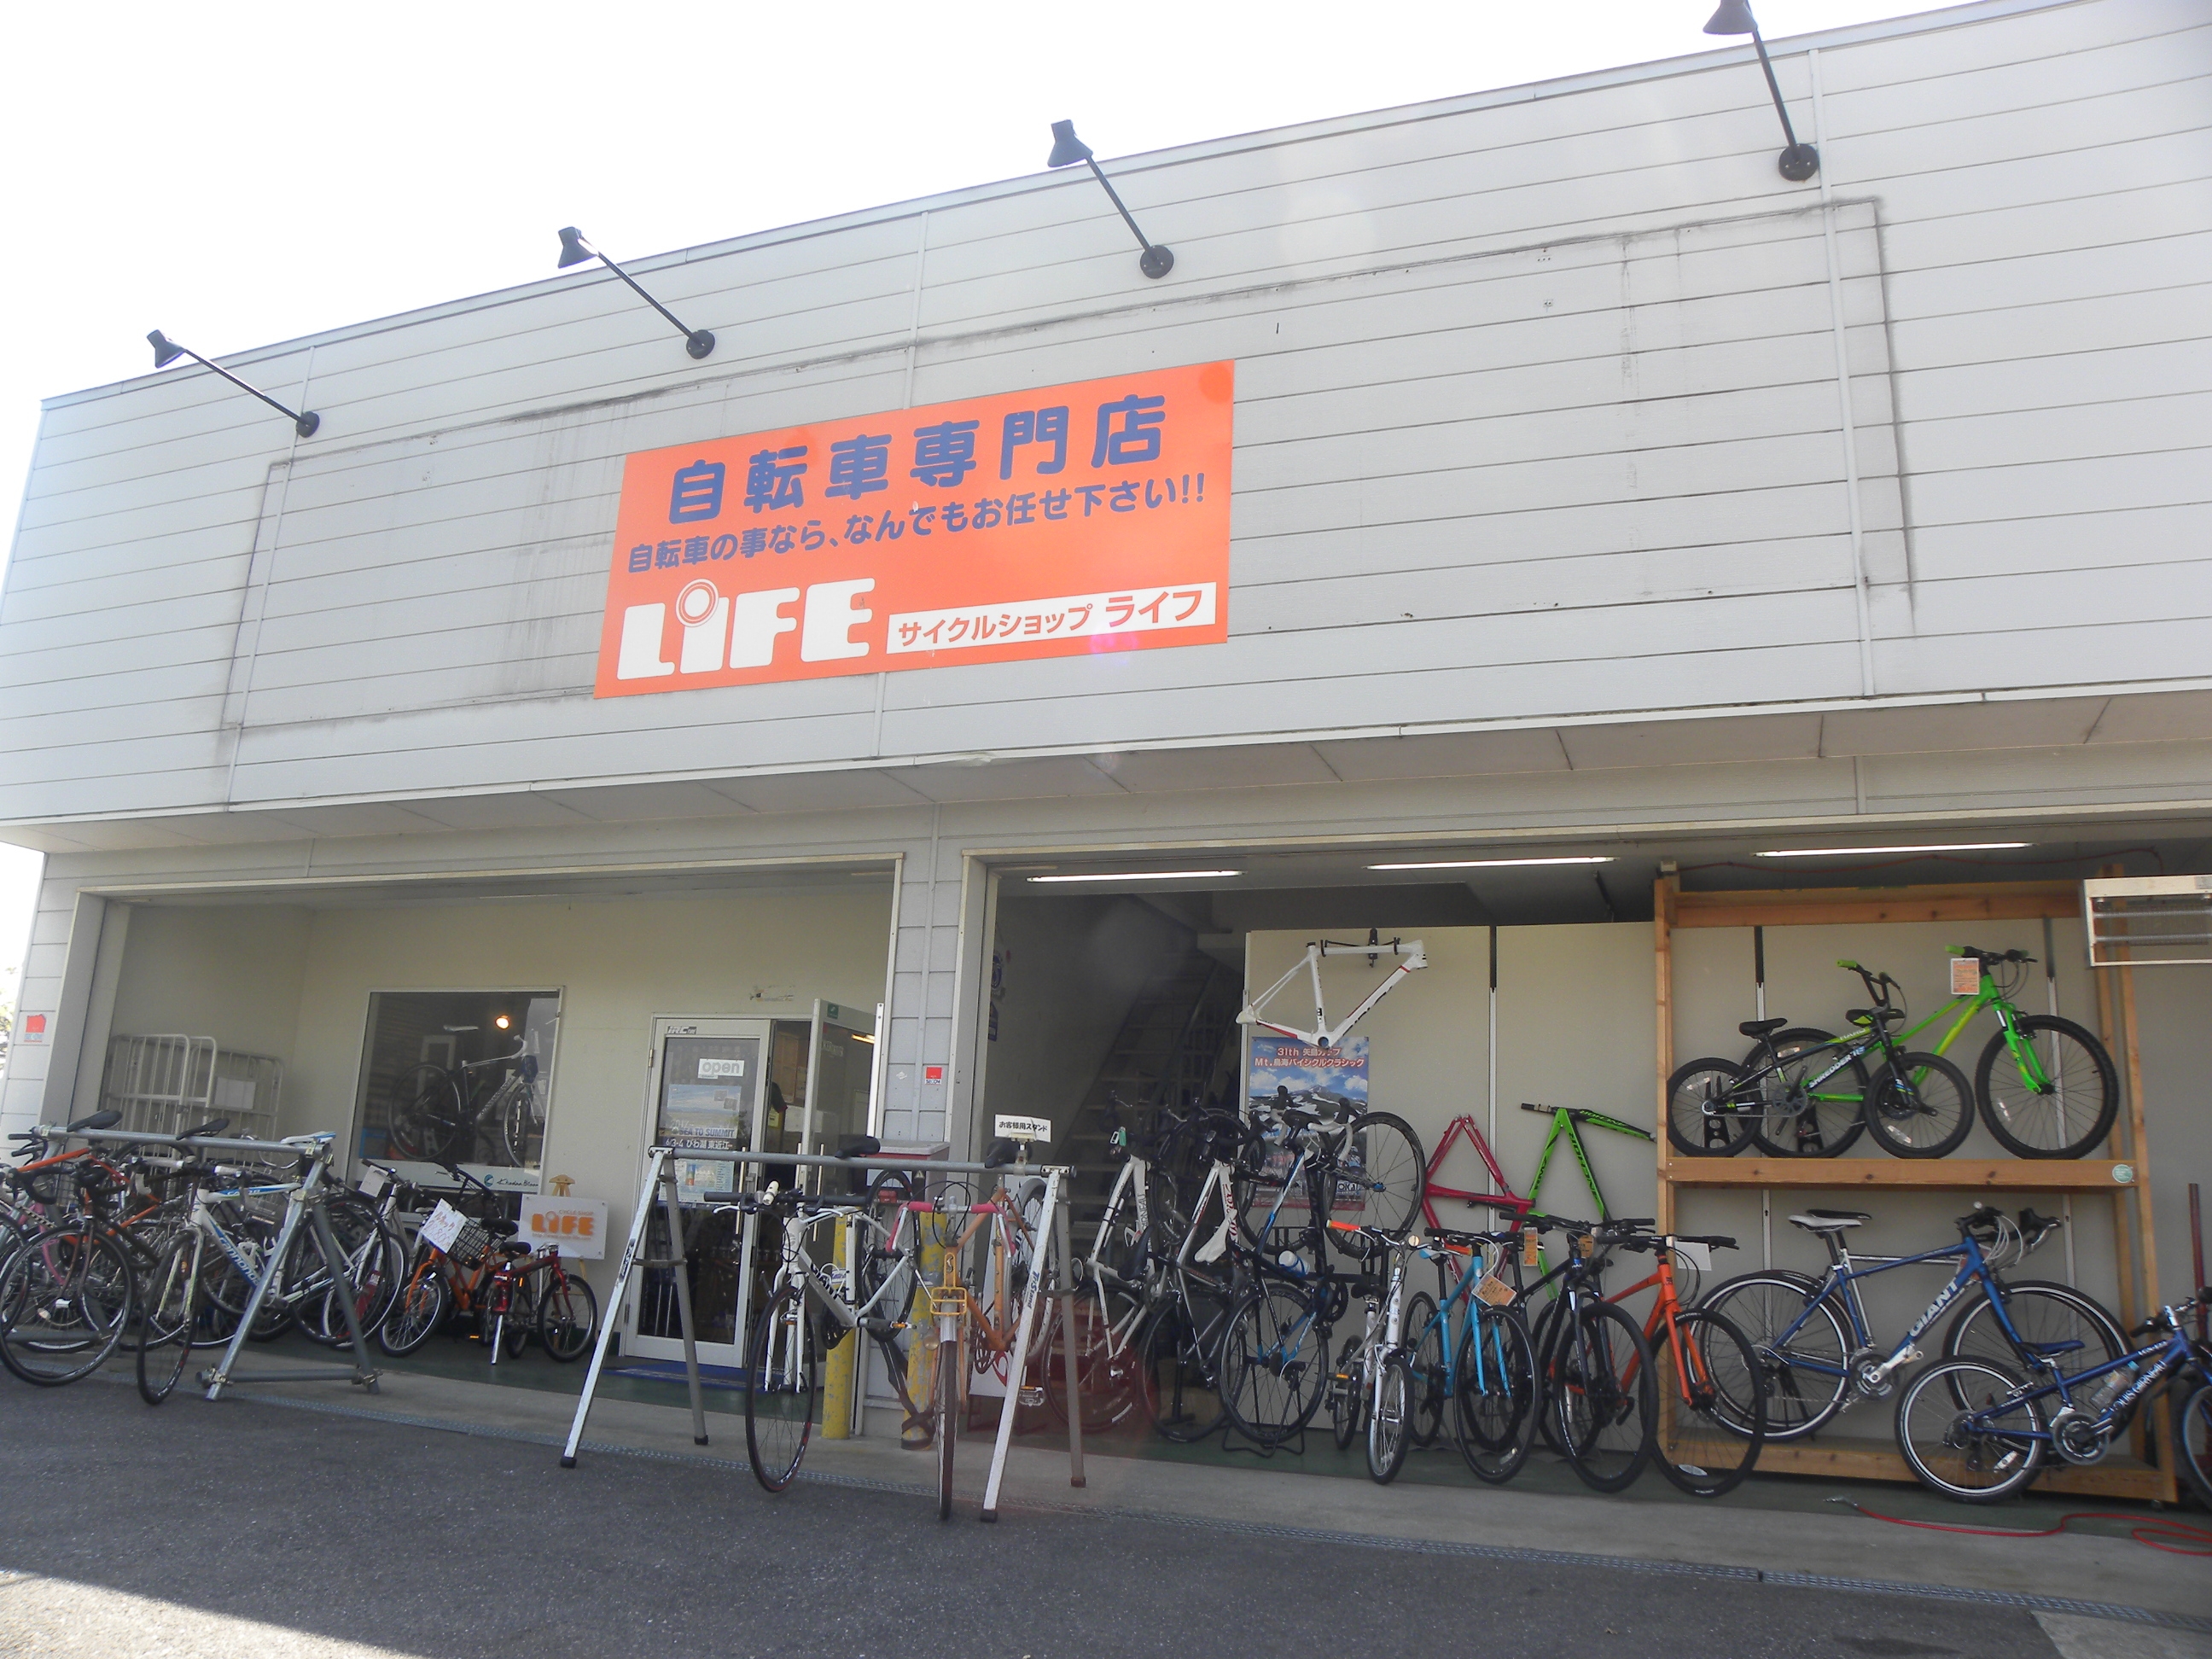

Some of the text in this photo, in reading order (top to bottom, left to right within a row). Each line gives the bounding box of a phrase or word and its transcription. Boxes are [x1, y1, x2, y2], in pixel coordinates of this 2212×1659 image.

[669, 393, 1166, 525] 自転車専門店
[899, 589, 1203, 647] サイクルショップ ライフ
[702, 1062, 740, 1075] open
[1278, 1048, 1299, 1057] 31th
[1808, 1054, 1852, 1088] SHREDDER
[706, 1128, 734, 1138] SUMMIT
[999, 1121, 1048, 1132] お客様用スタンド
[219, 1237, 262, 1286] cannonda
[1027, 1271, 1039, 1309] TriStand
[1910, 1278, 1959, 1337] GIANT
[2132, 1359, 2168, 1394] GARNEAU
